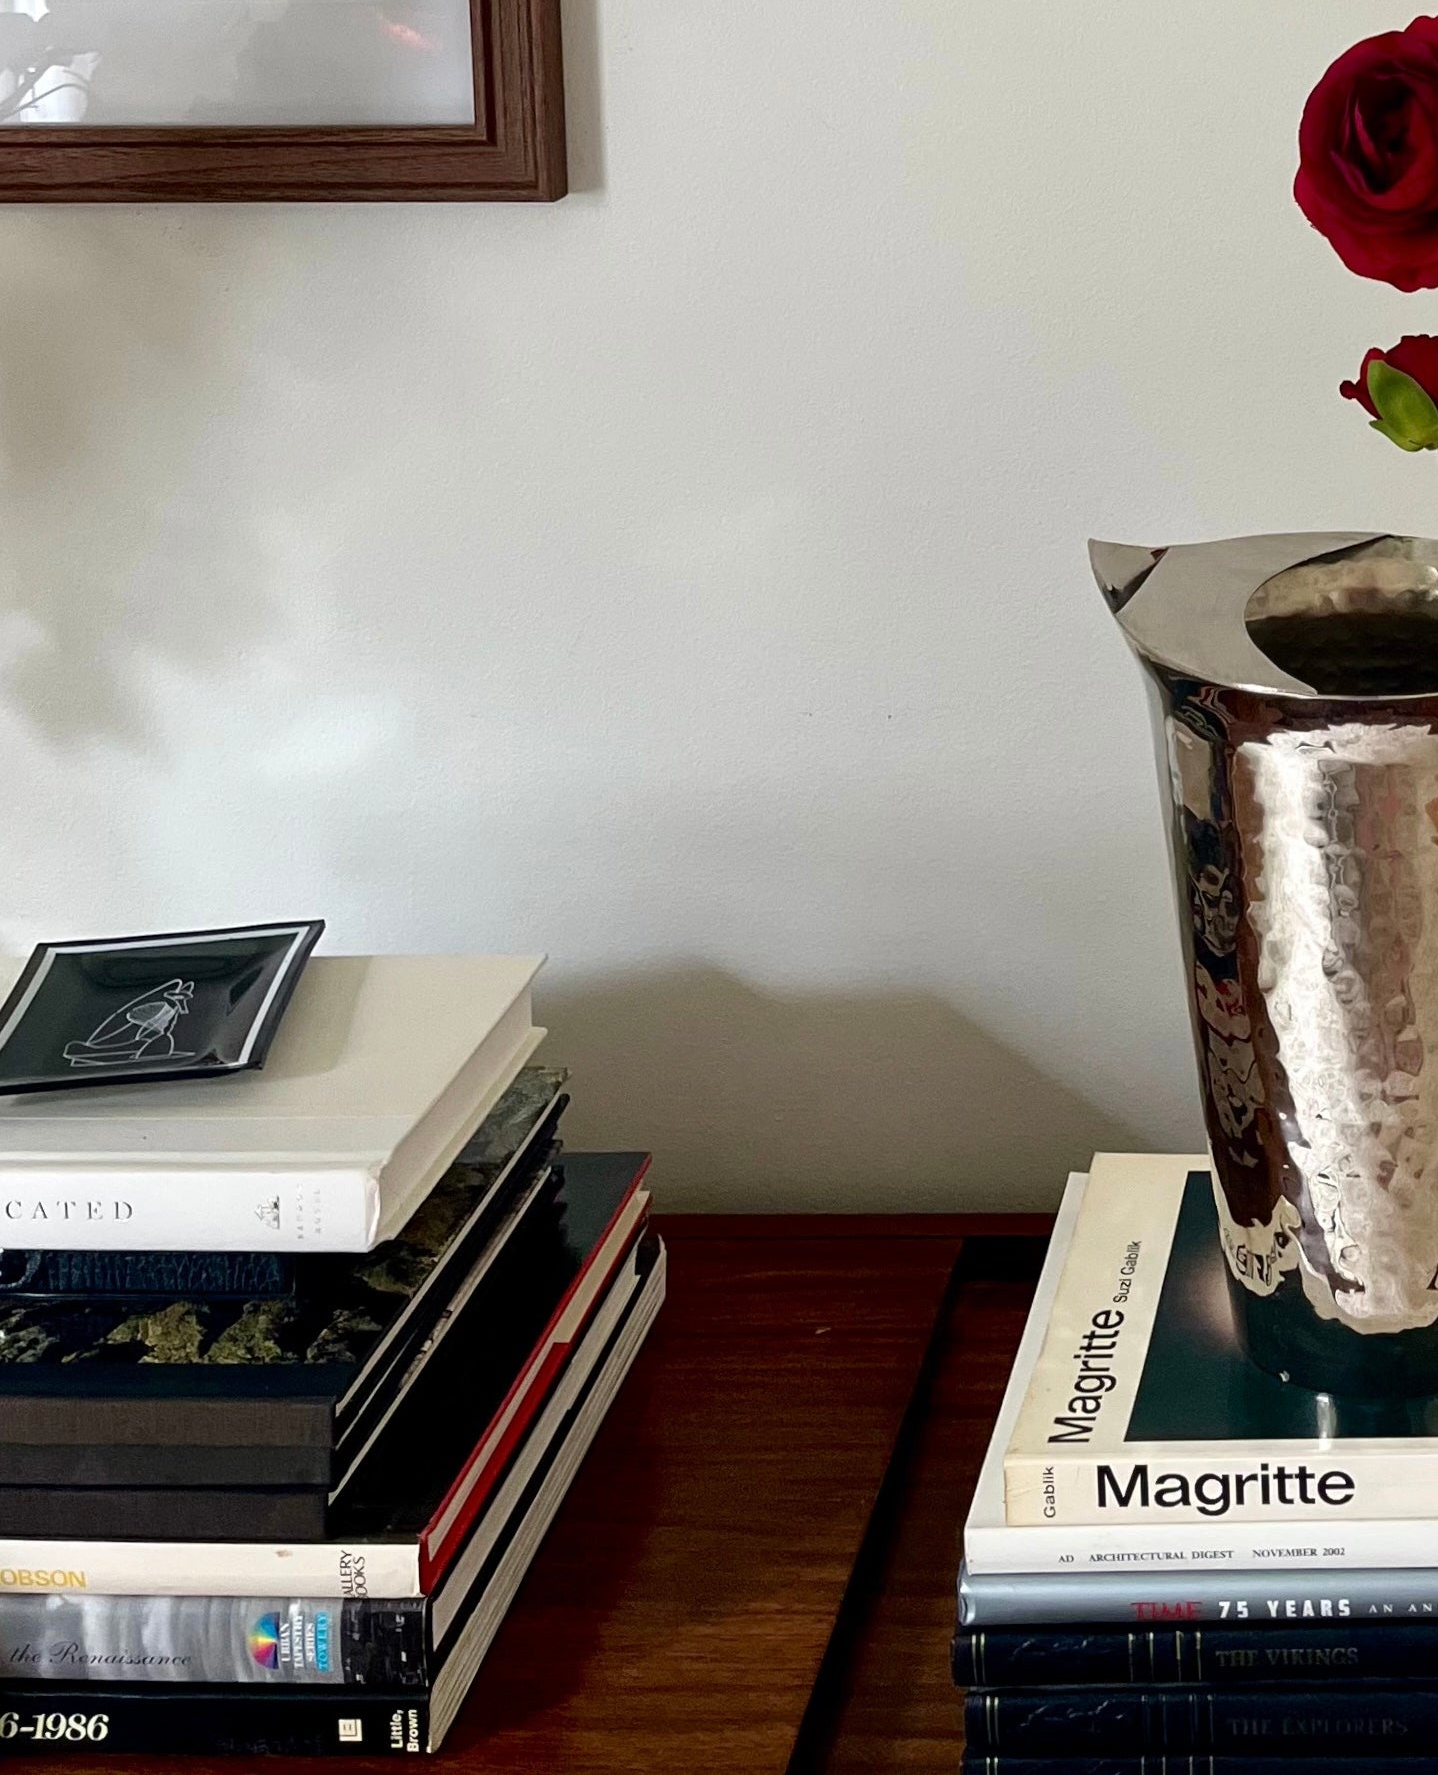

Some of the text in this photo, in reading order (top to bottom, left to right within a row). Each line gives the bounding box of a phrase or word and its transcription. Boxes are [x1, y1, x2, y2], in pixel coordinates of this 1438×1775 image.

[5, 1200, 134, 1221] CATED
[1047, 1309, 1124, 1443] Magritte
[1120, 1240, 1142, 1275] Gablik
[1043, 1466, 1056, 1519] Gablik
[1096, 1462, 1356, 1517] Magritte
[1058, 1547, 1346, 1563] AD ARCHITECTURAL DIGEST NOVEMBER 2002
[0, 1568, 87, 1589] OBSON
[353, 1556, 369, 1598] OOKS
[1218, 1600, 1249, 1619] 75
[1266, 1598, 1351, 1618] YEARS
[1368, 1603, 1394, 1613] AN
[10, 1640, 192, 1665] the Renaissance
[1216, 1646, 1359, 1667] THE VIKINGS
[0, 1712, 110, 1741] 6-1986
[389, 1709, 404, 1749] Little,
[406, 1709, 420, 1753] Brown
